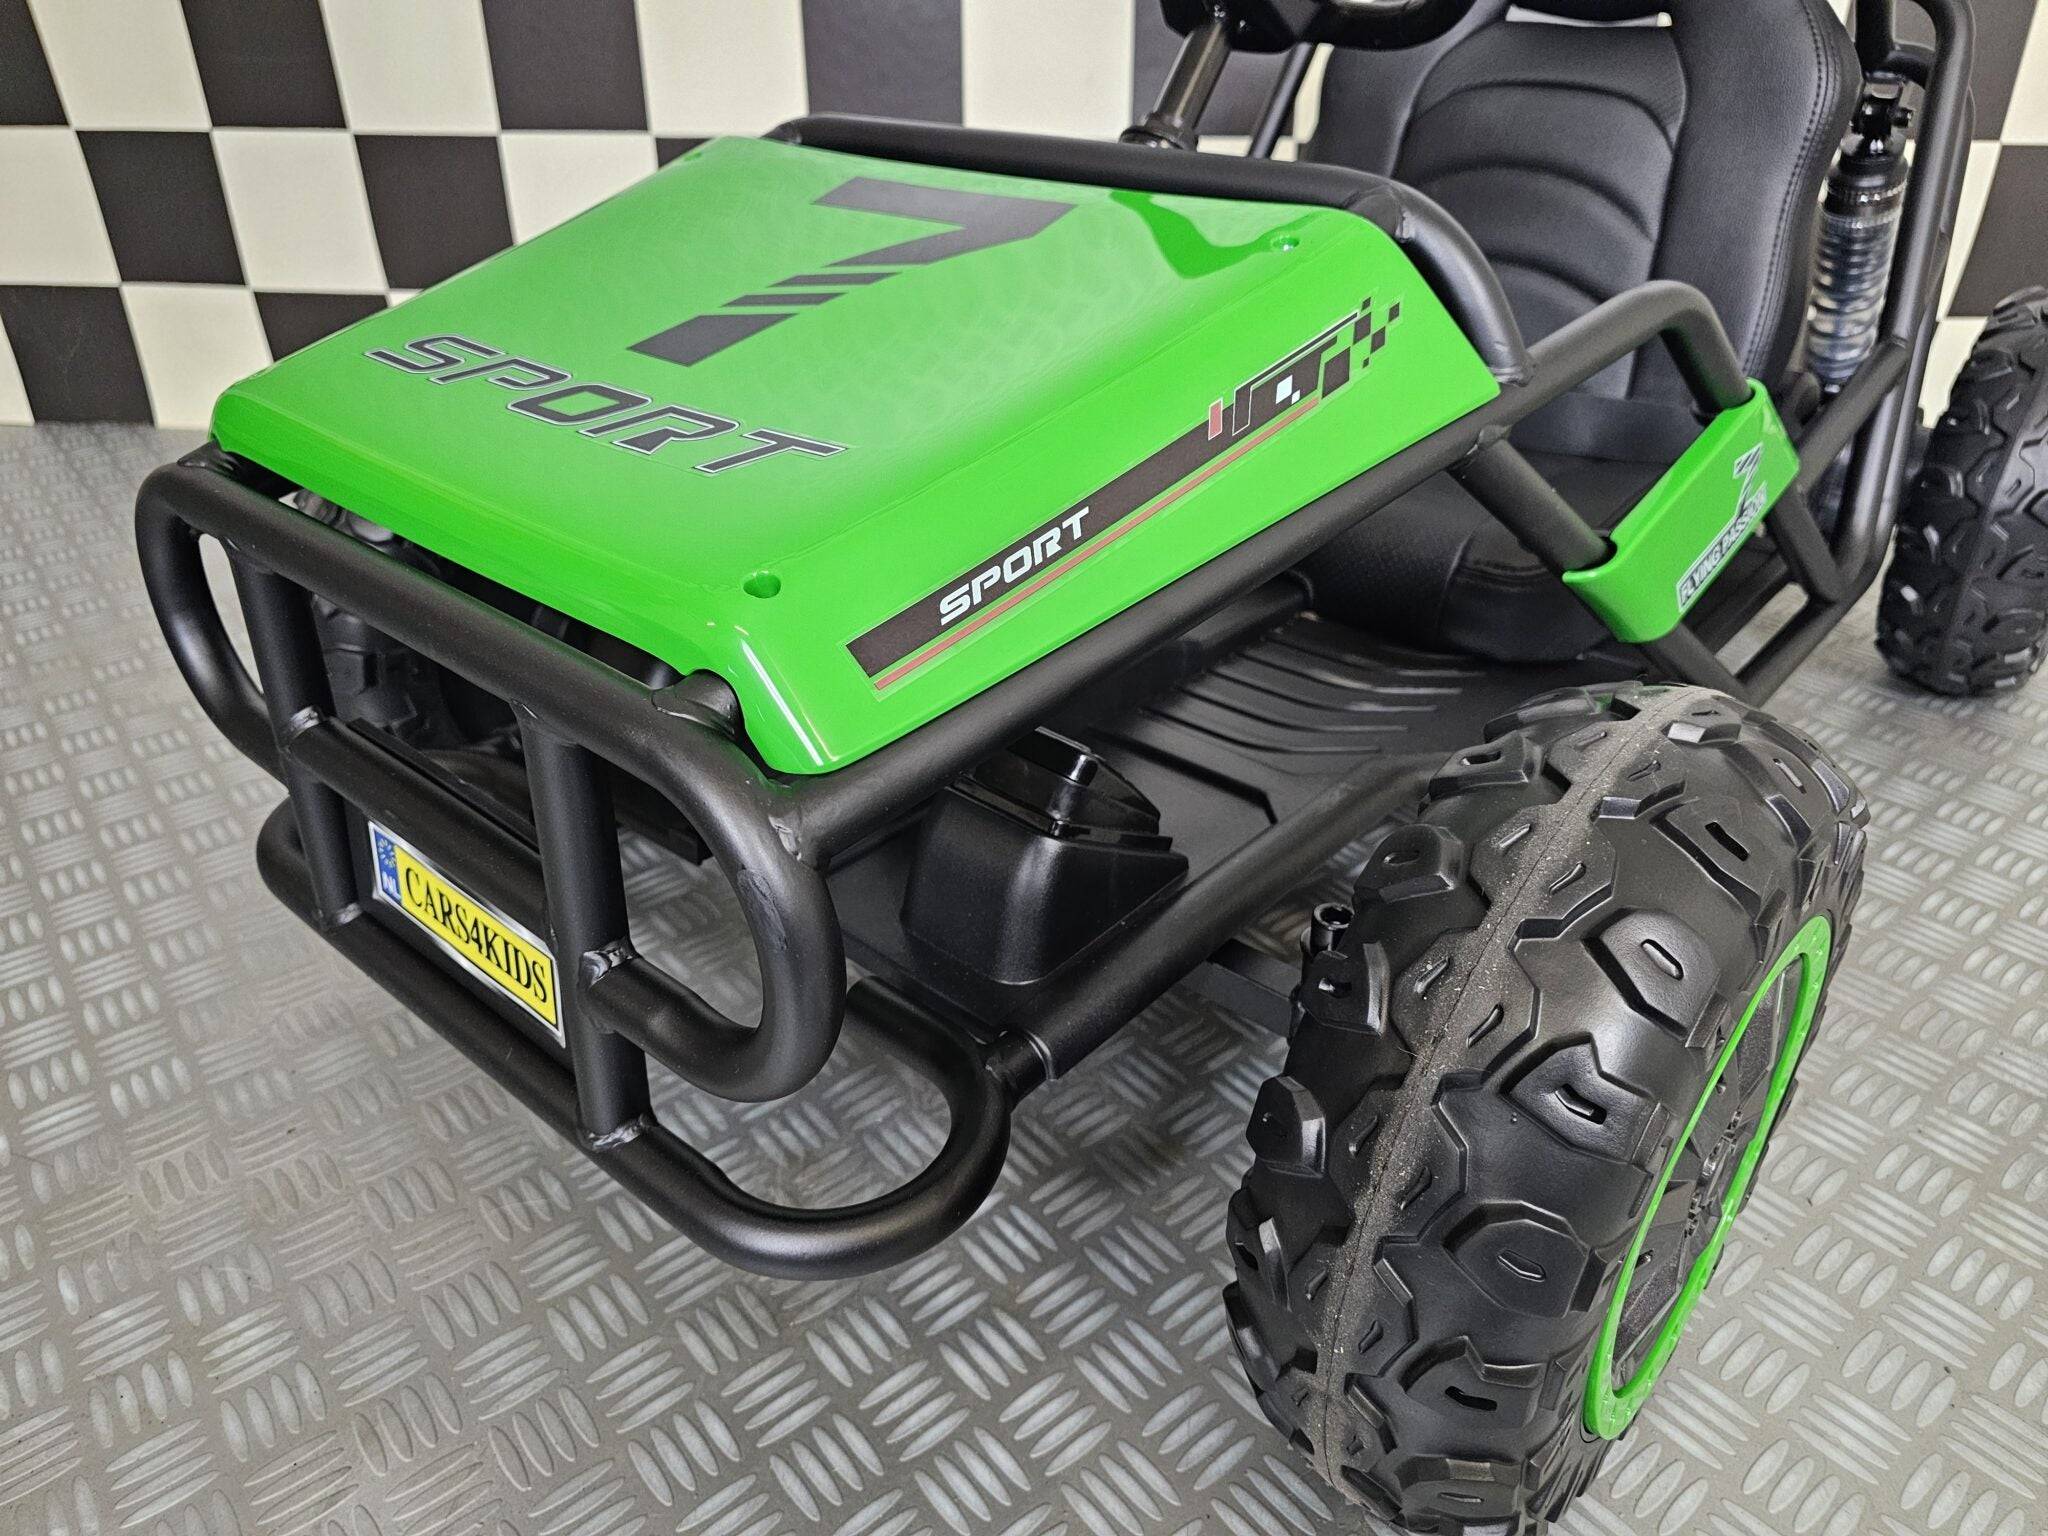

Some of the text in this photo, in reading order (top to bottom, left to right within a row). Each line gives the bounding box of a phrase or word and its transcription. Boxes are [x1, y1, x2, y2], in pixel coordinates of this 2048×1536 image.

[364, 334, 848, 475] SPORT
[940, 506, 1090, 626] SPORT
[405, 866, 548, 1004] CARS4KIDS
